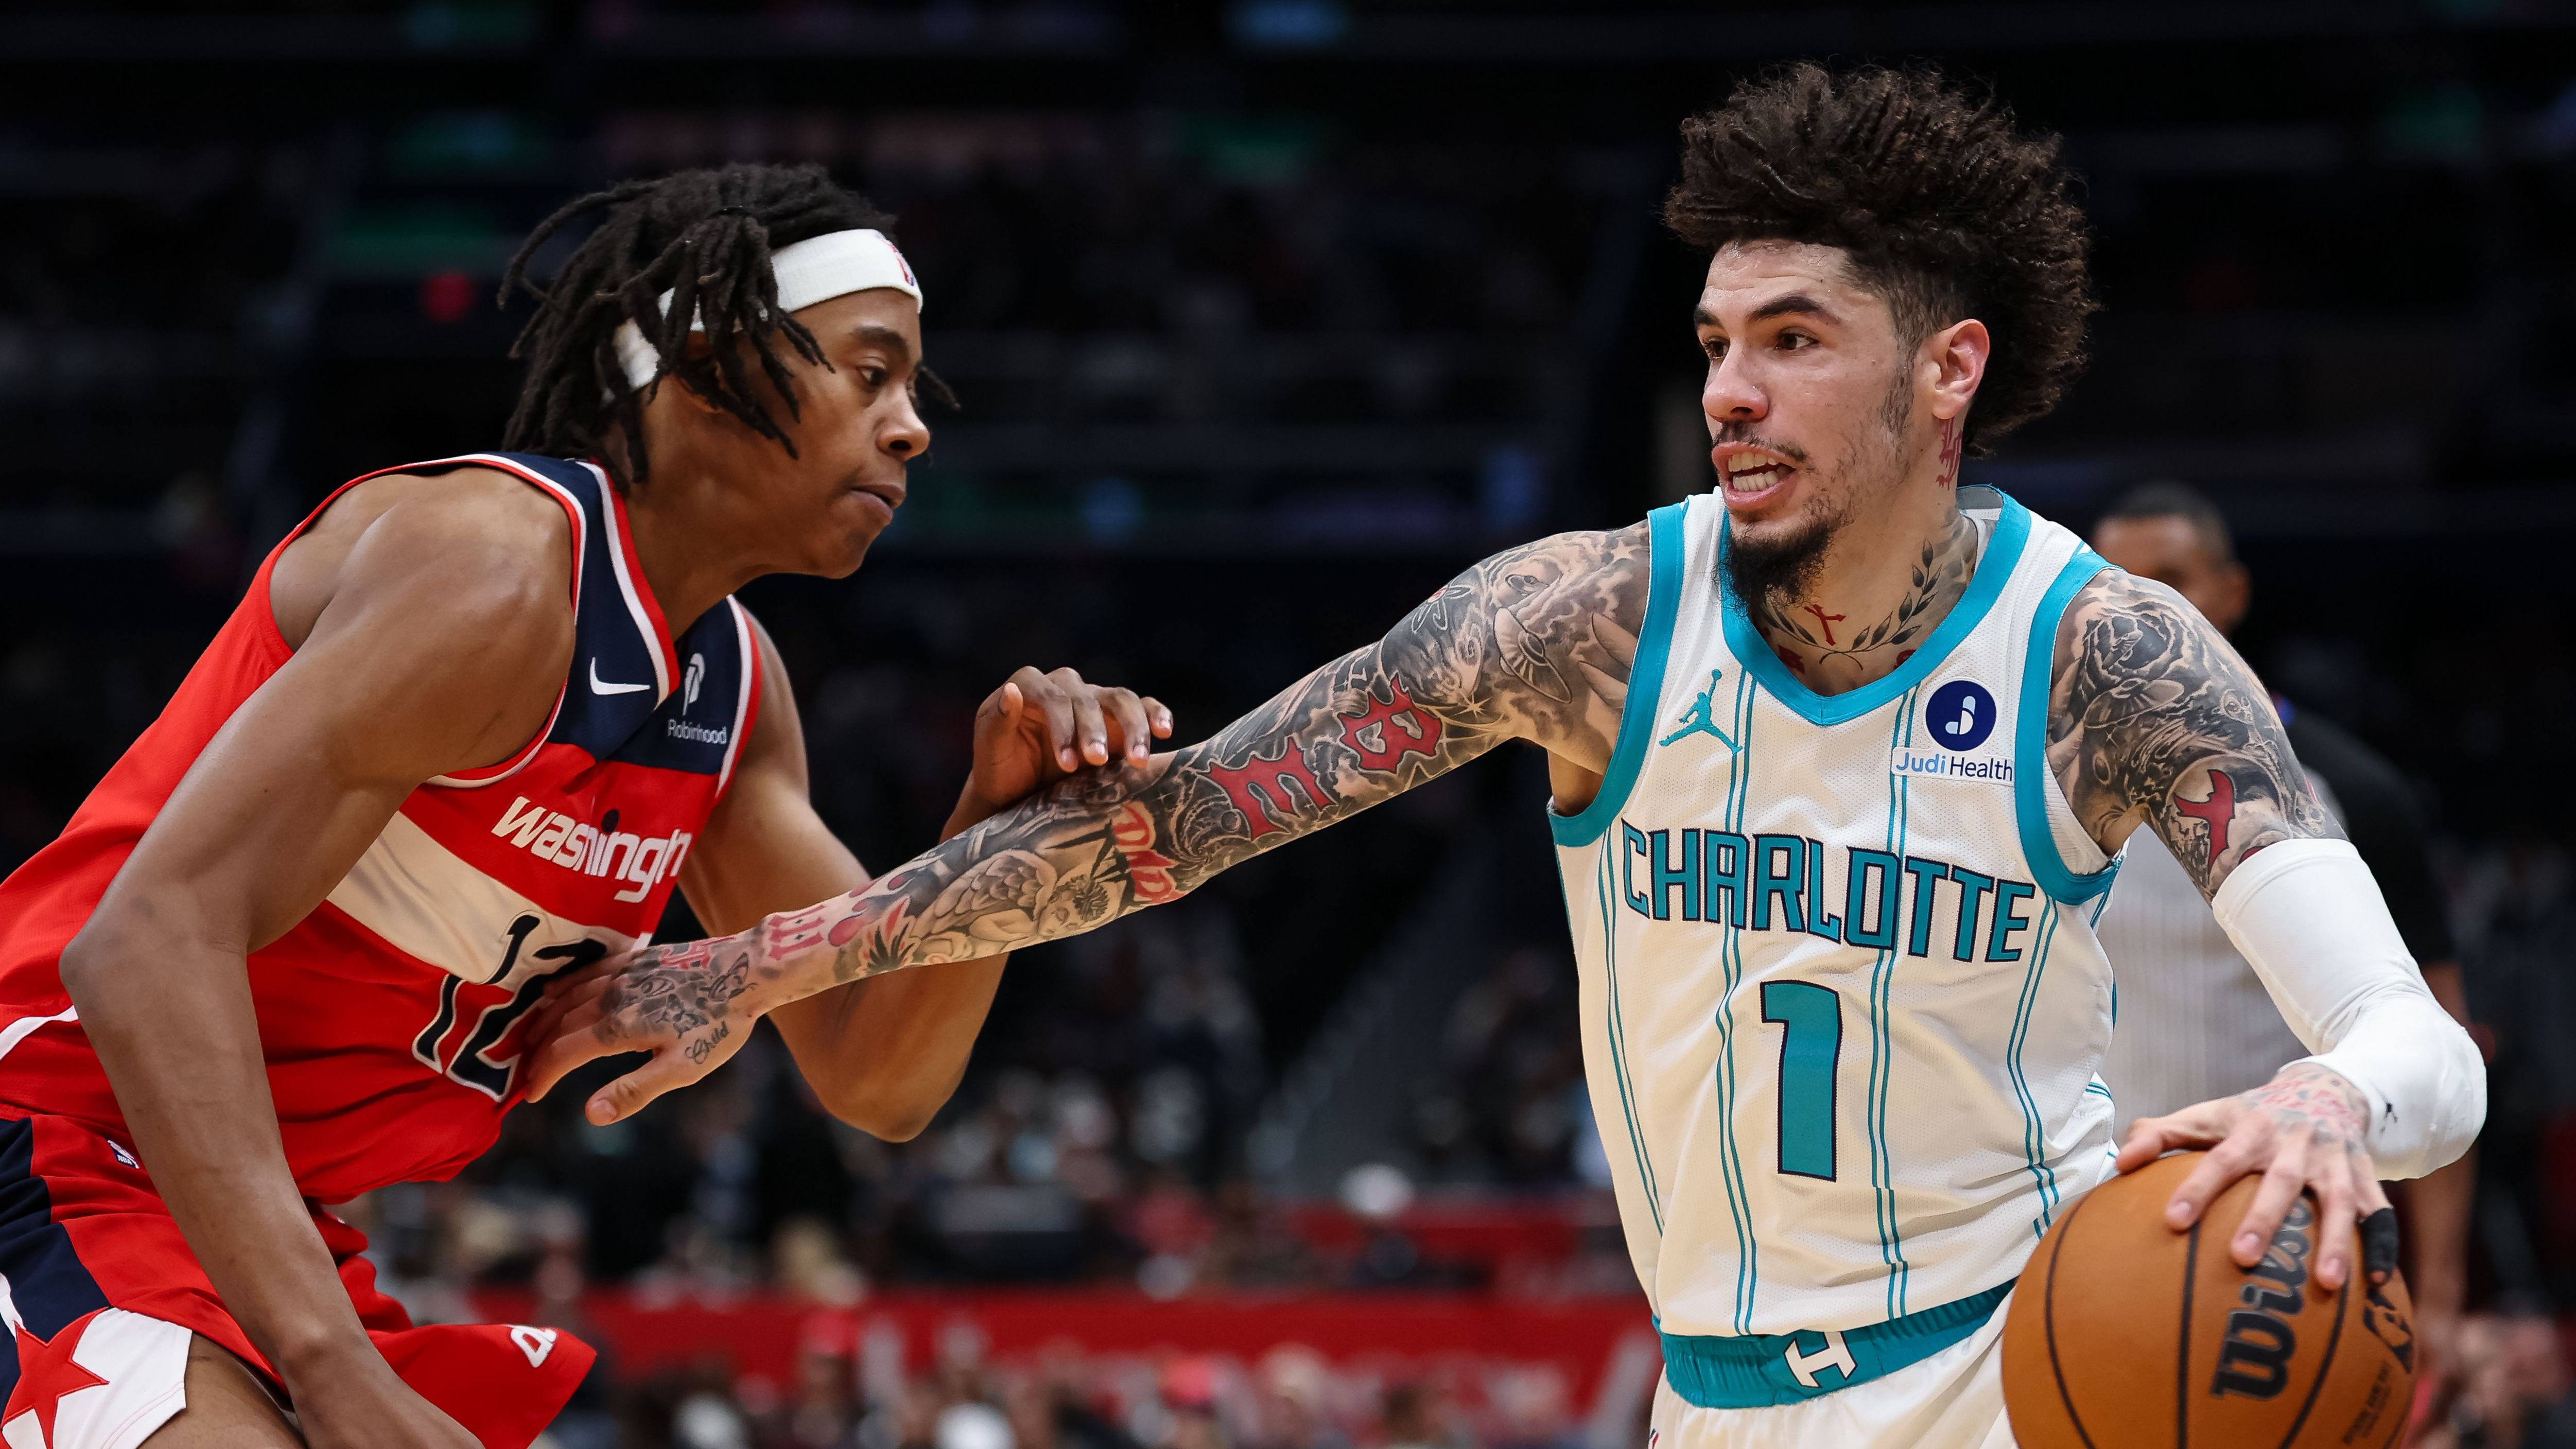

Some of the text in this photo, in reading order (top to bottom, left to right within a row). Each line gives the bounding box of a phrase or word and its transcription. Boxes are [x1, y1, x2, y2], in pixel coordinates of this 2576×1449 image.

[1896, 752, 2013, 781] Judi Health
[1622, 818, 2036, 963] CHARLOTTE
[1760, 979, 1843, 1182] 1
[117, 1154, 133, 1165] NBA
